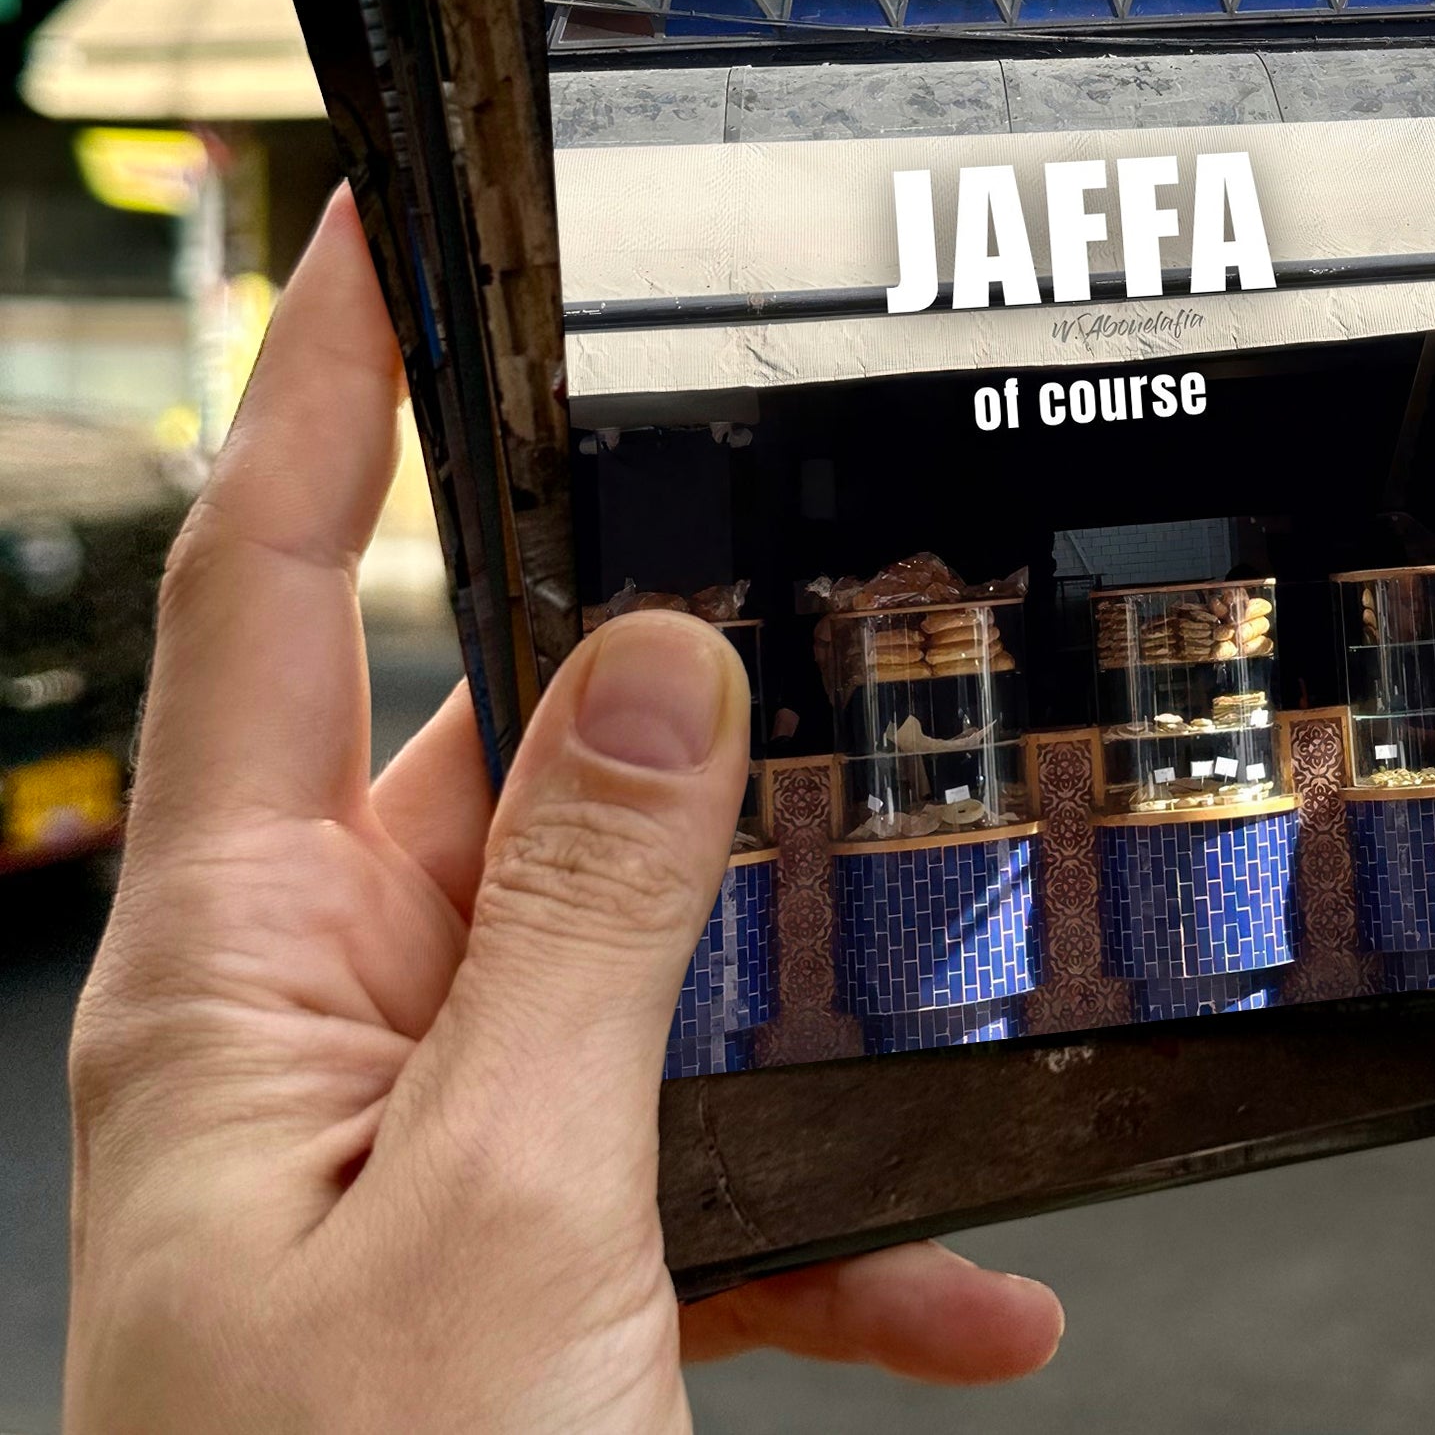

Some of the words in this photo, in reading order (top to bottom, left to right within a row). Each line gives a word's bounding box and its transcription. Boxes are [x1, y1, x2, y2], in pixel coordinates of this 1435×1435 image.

[886, 151, 1277, 314] JAFFA
[974, 377, 1020, 431] of
[1039, 371, 1207, 426] course
